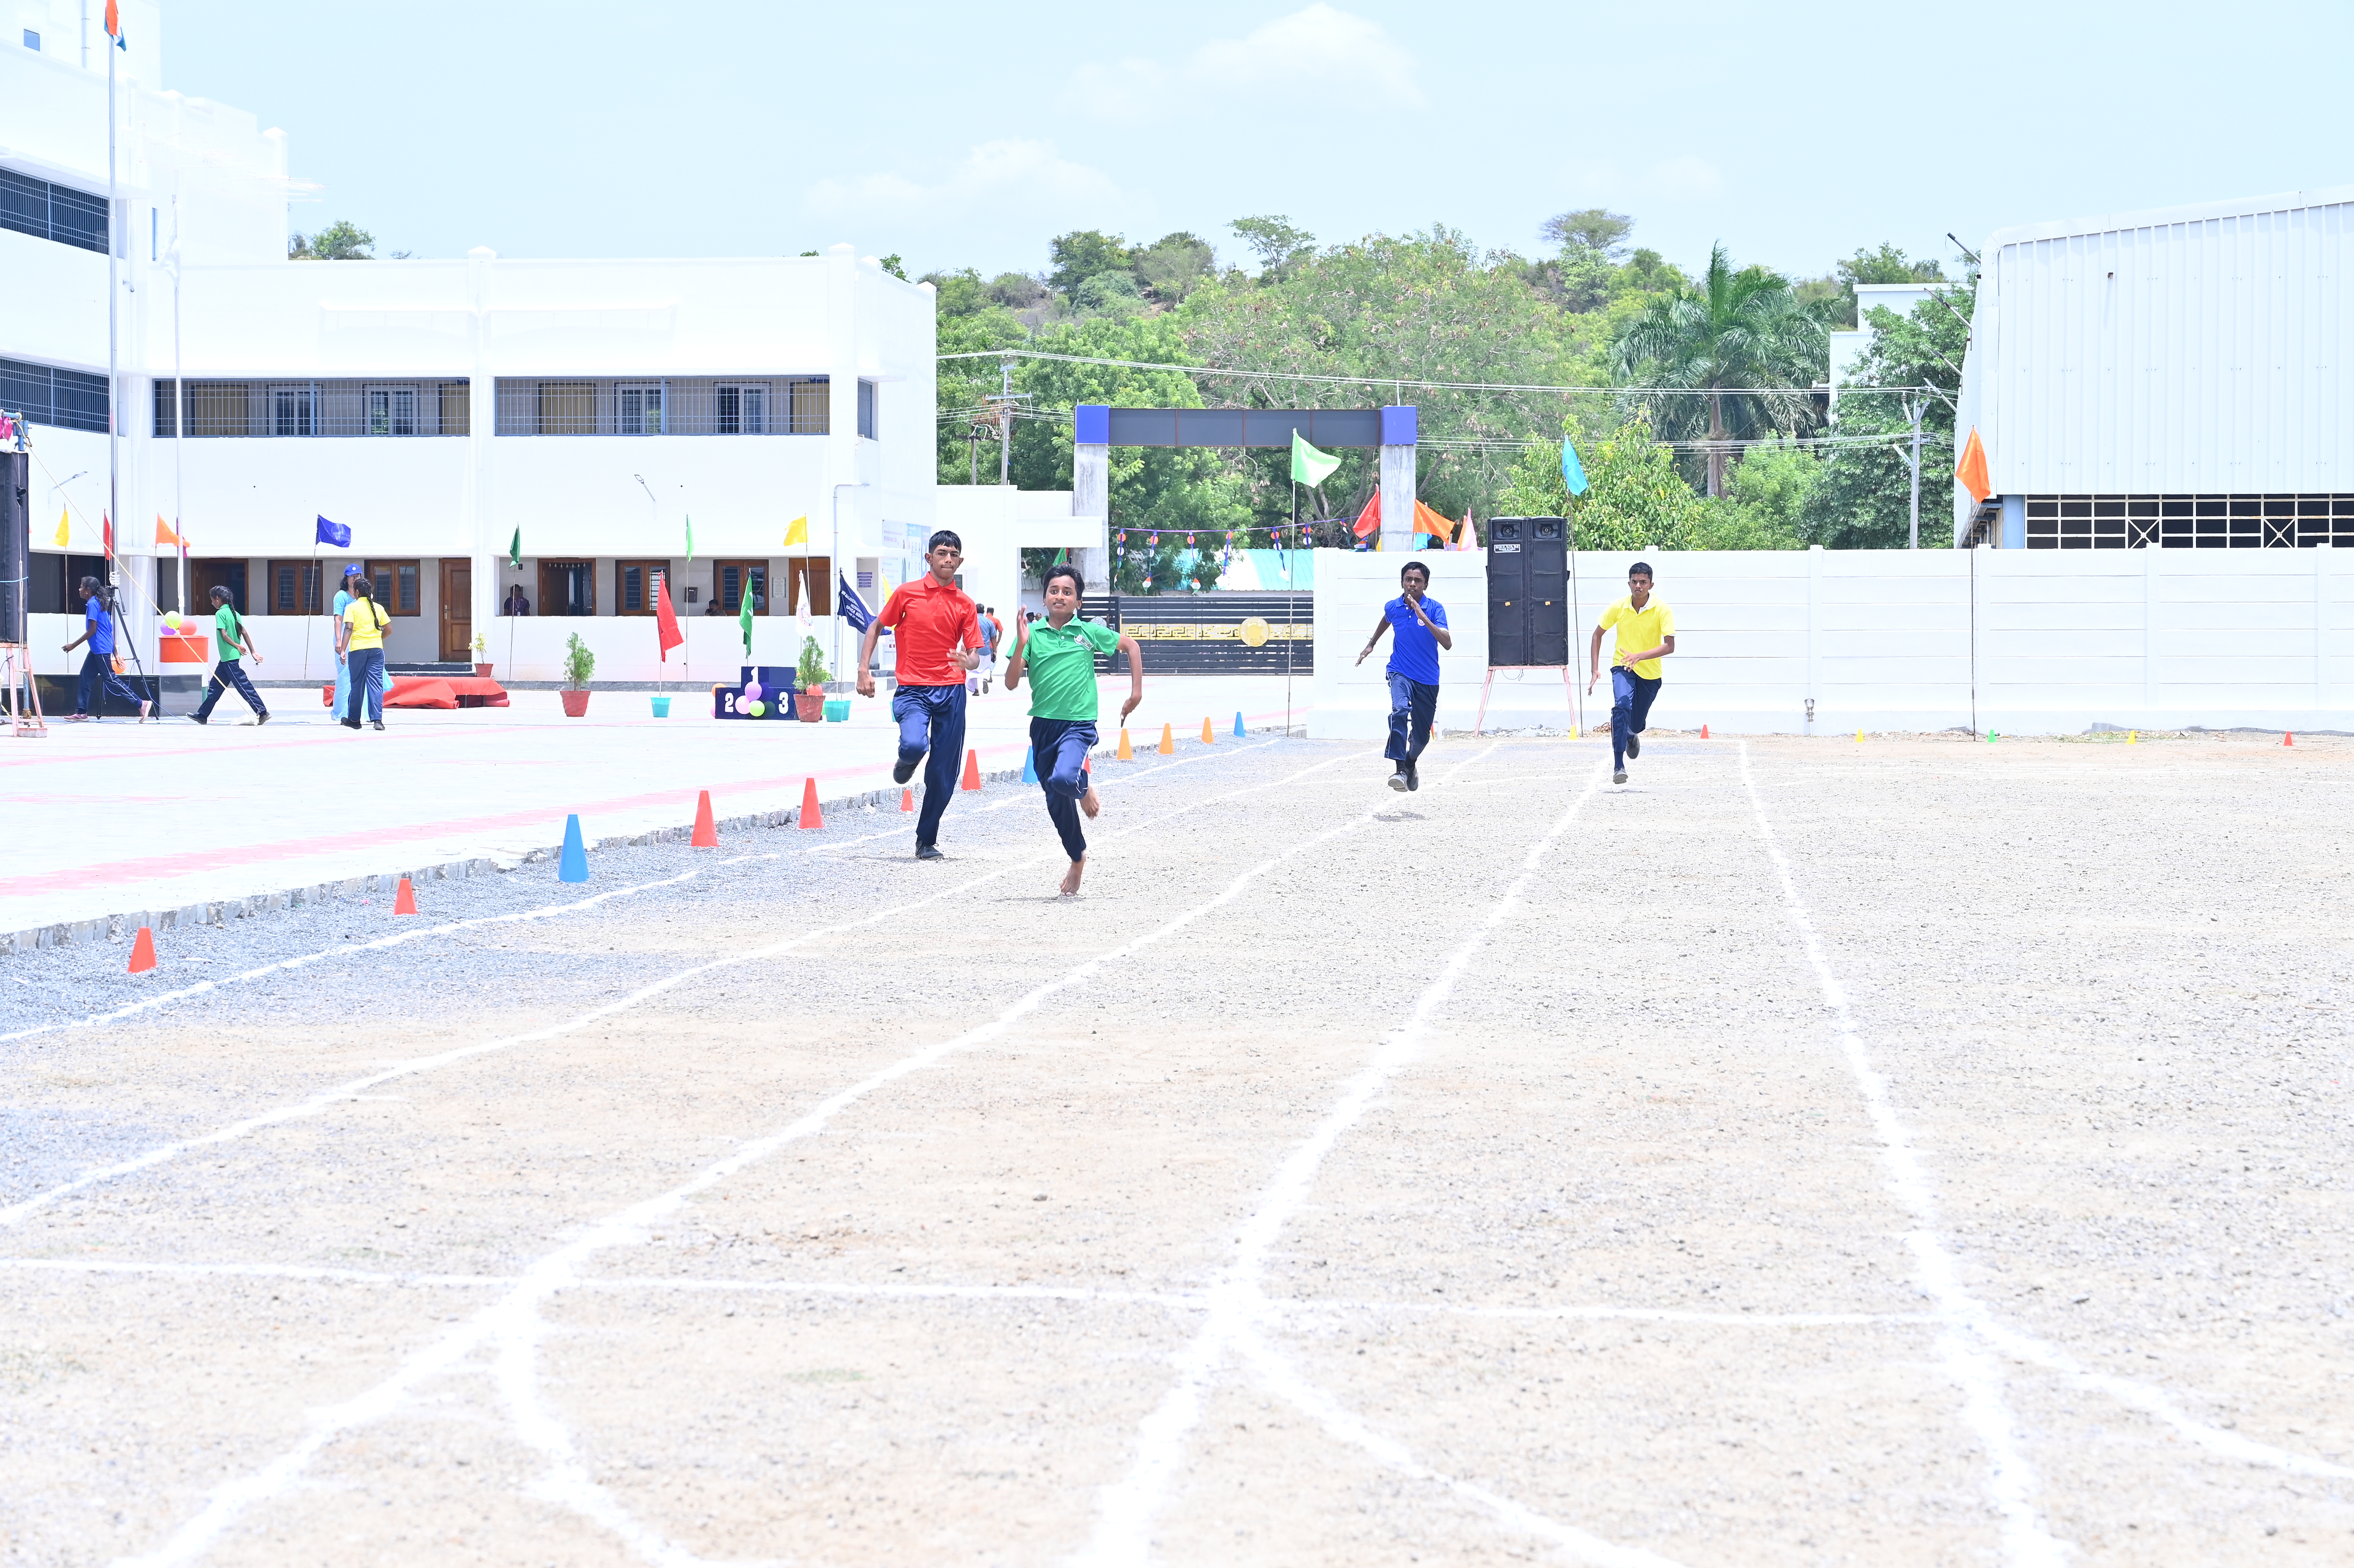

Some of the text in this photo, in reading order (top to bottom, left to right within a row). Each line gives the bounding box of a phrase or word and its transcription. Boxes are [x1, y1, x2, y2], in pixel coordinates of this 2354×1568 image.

[846, 605, 856, 614] SPICA
[751, 667, 758, 684] 1
[725, 692, 734, 713] 2
[778, 691, 789, 714] 3
